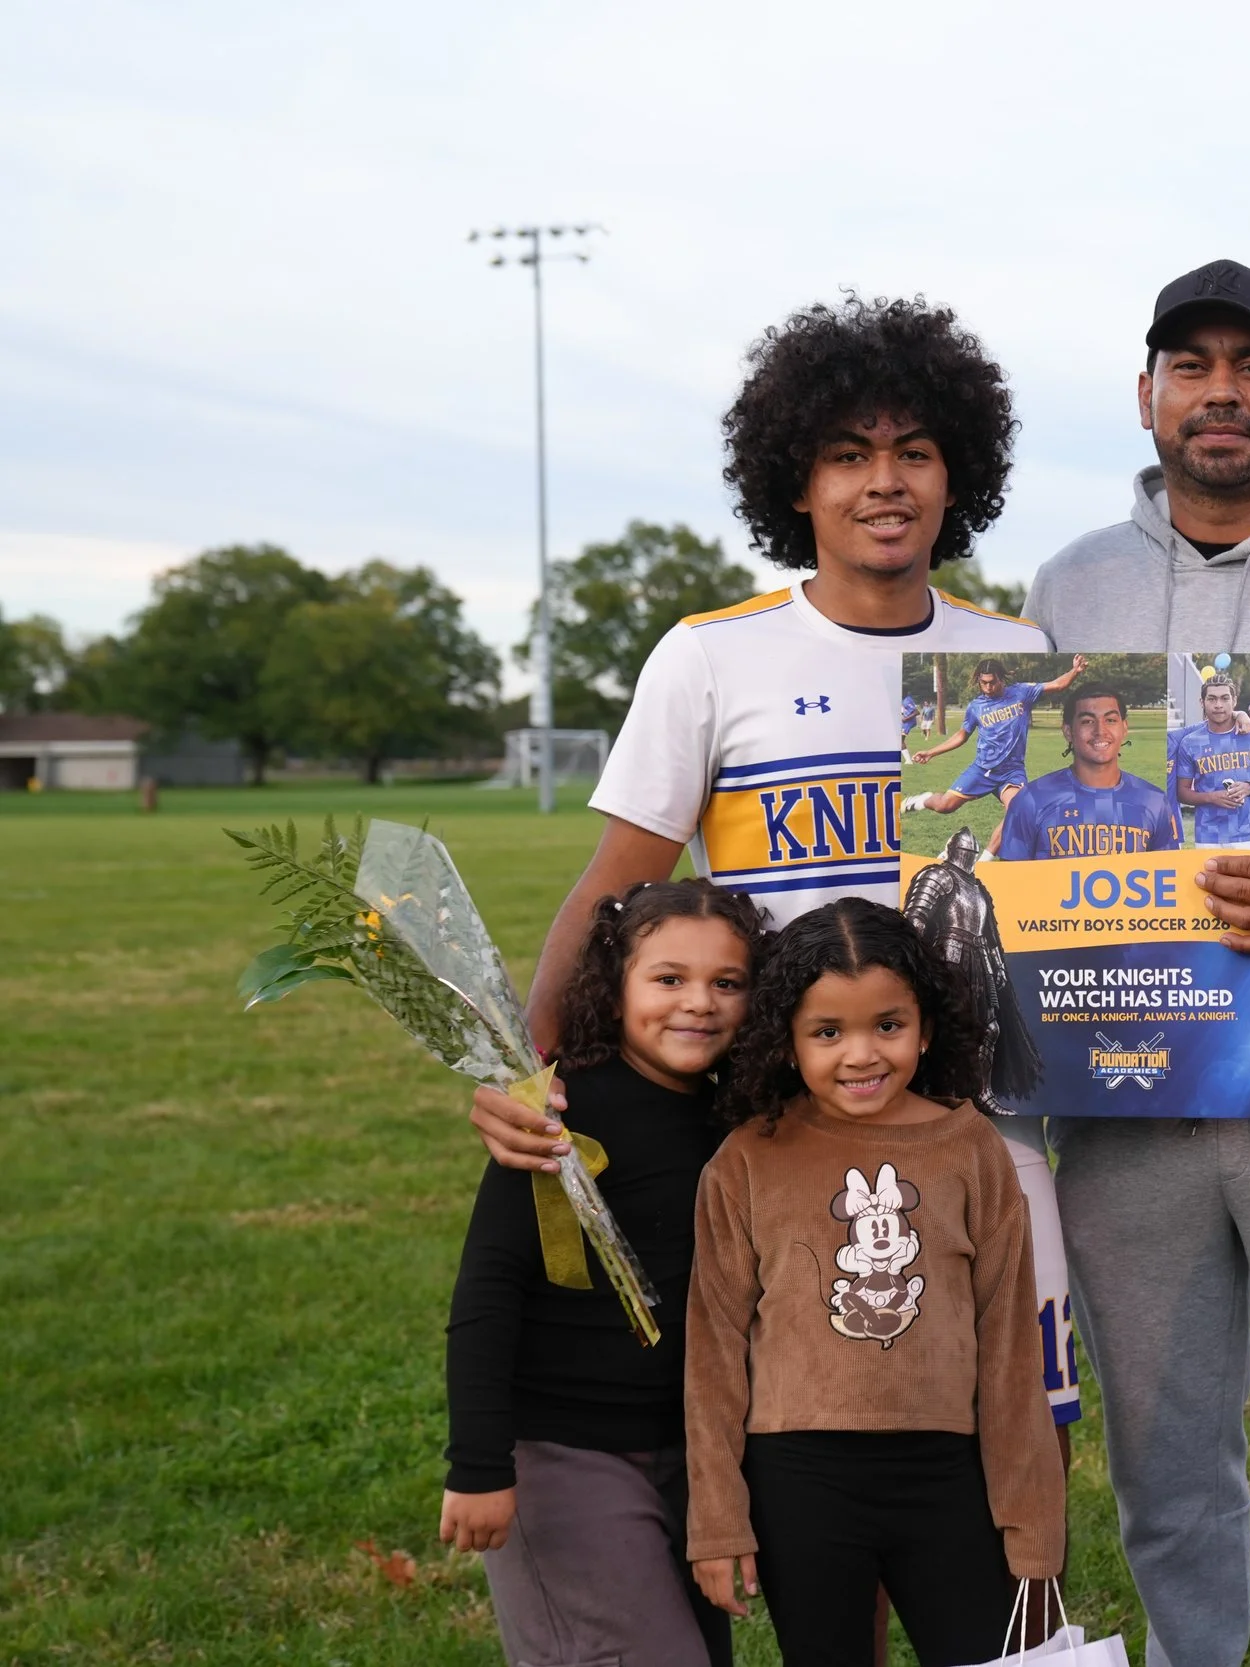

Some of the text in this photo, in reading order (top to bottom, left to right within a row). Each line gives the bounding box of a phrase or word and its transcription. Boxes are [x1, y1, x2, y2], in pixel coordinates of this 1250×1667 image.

[980, 702, 1025, 728] KNIGHTS
[1060, 869, 1177, 910] JOSE
[1018, 917, 1231, 932] VARSITY BOYS SOCCER 2026
[1039, 968, 1193, 987] YOUR KNIGHTS
[1039, 989, 1233, 1008] WATCH HAS ENDED
[1041, 1012, 1239, 1022] BUT ONCE A KNIGHT, ALWAYS A KNIGHT.
[1092, 1049, 1167, 1068] FOUNDATION
